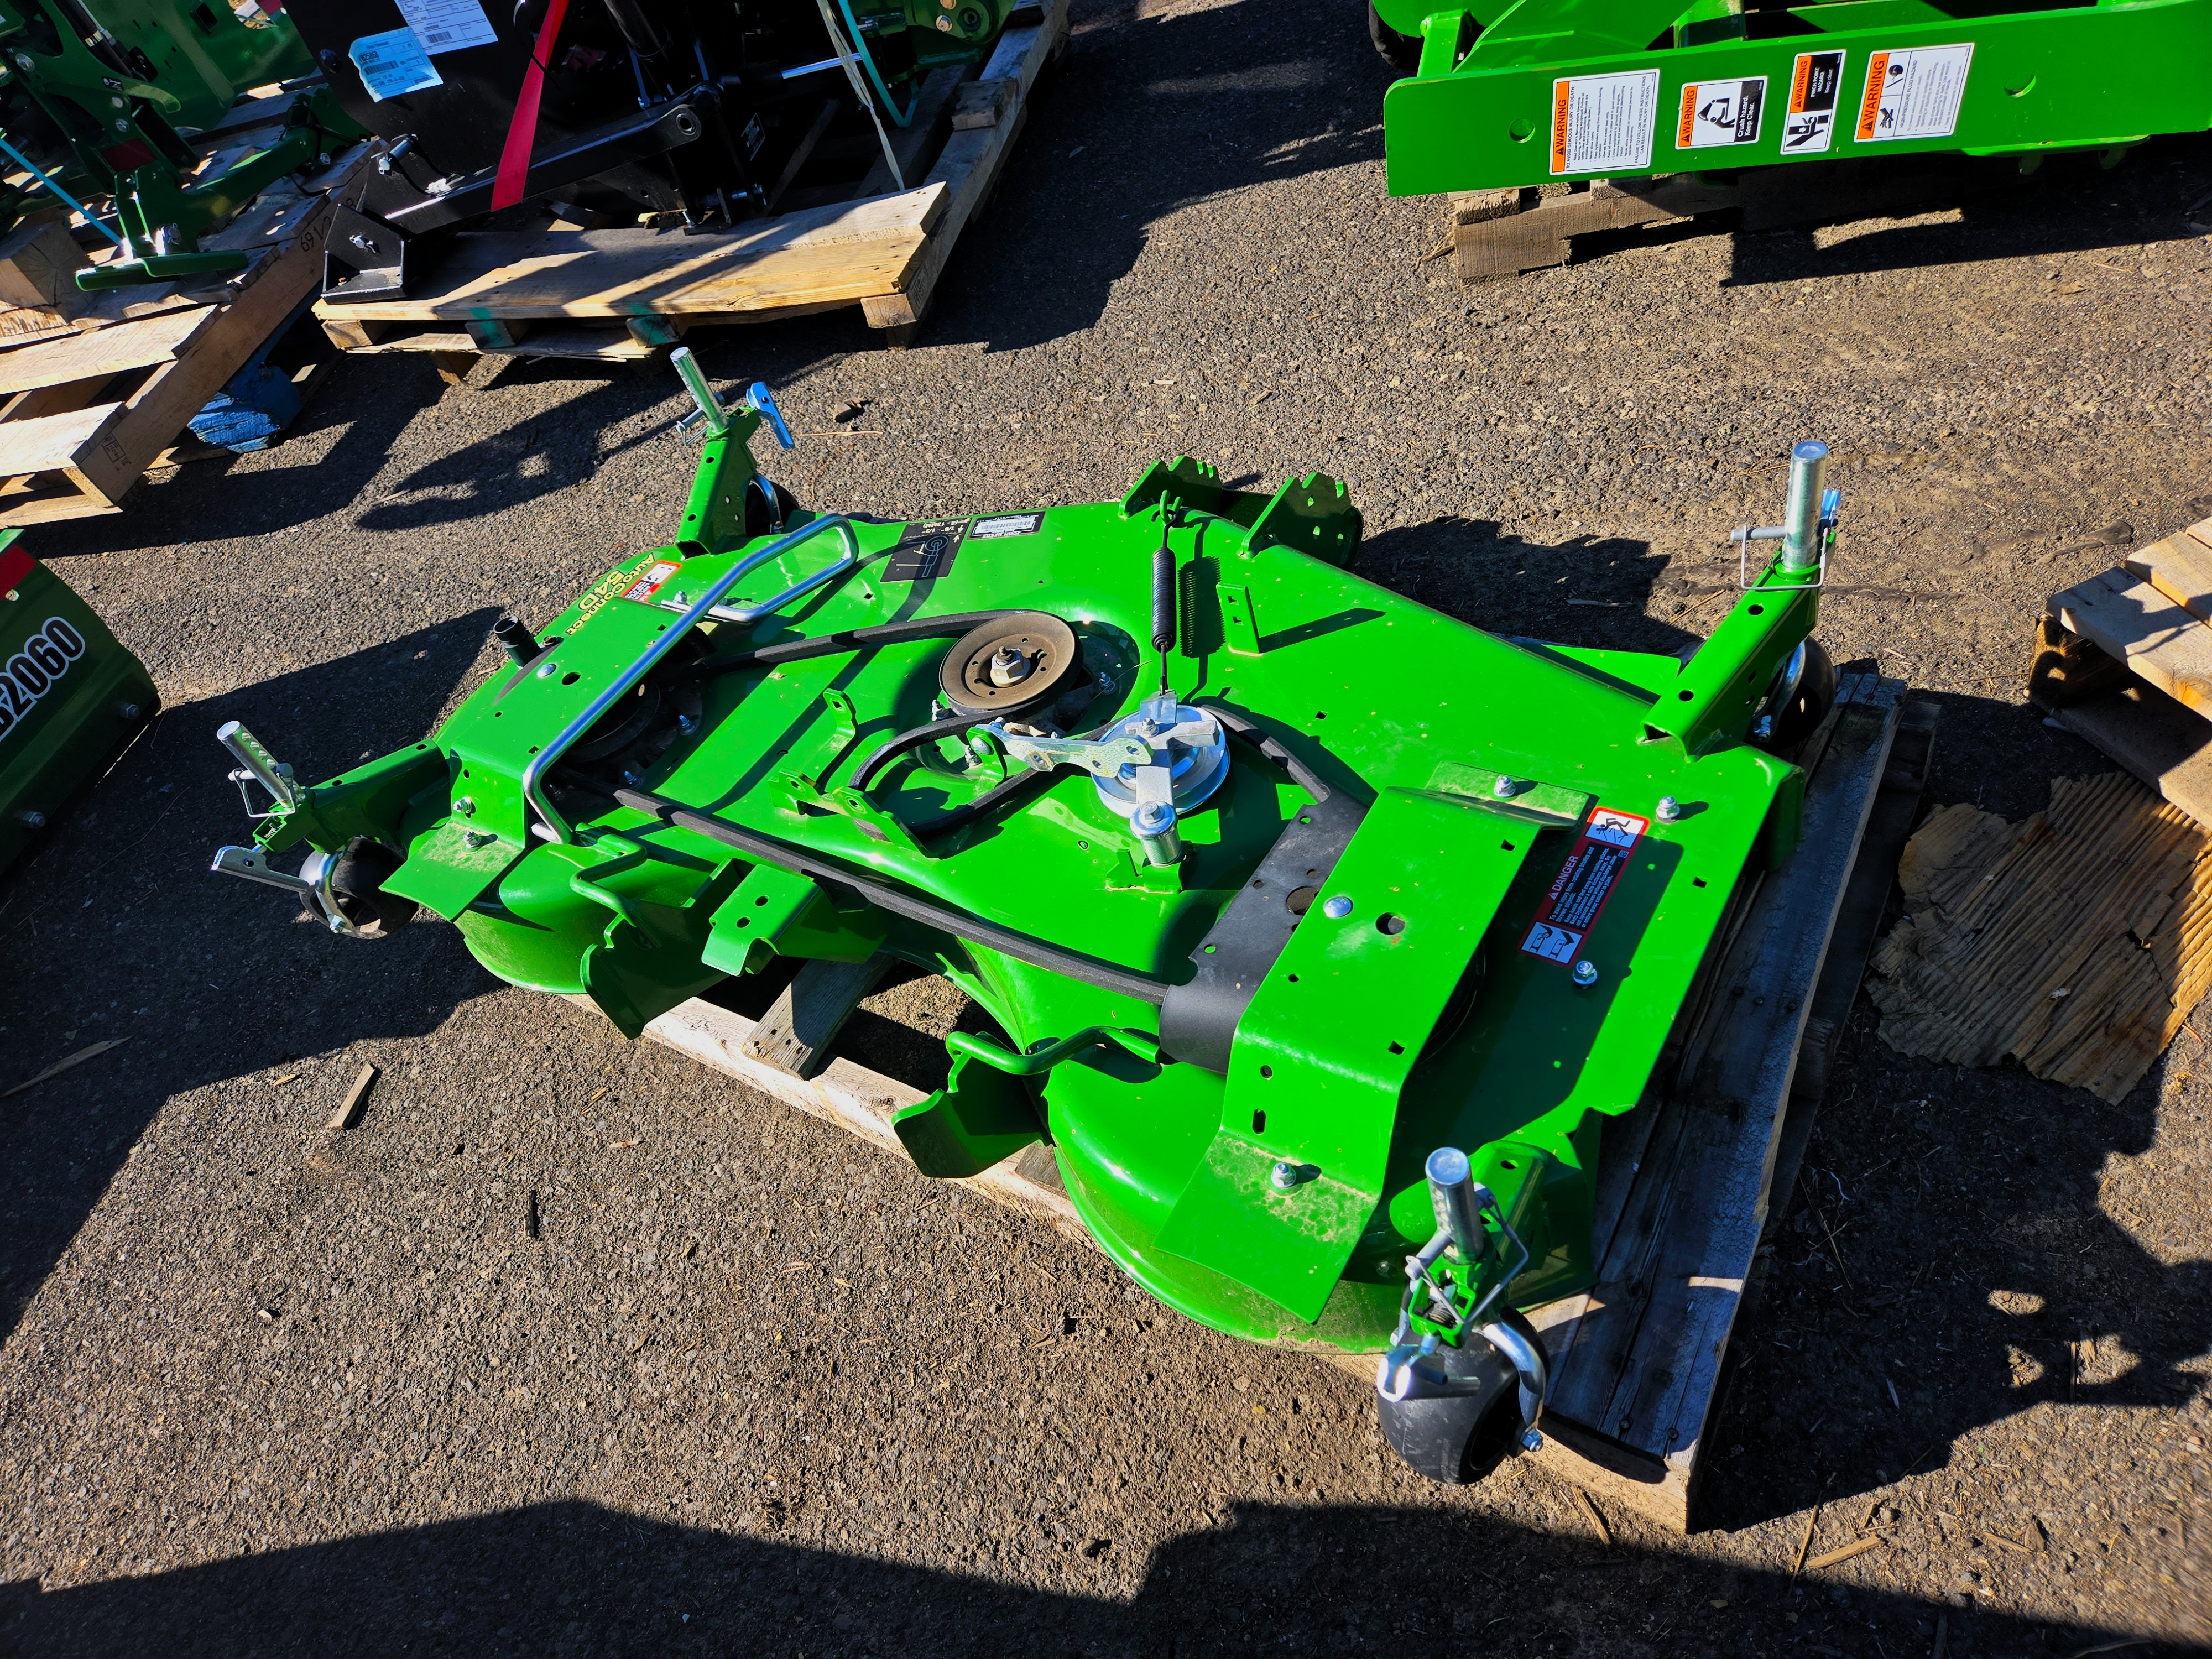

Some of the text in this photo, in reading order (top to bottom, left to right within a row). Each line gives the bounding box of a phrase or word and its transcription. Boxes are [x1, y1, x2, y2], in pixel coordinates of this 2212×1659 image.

[1794, 61, 1808, 100] WARNING
[1863, 60, 1885, 121] WARNING
[1556, 99, 1566, 147] WARNING
[1682, 90, 1694, 134] WARNING
[1736, 95, 1748, 137] Crush hazard.
[1744, 102, 1755, 136] Keep Clear.
[1899, 93, 1910, 127] HIGH-PRESSURE
[300, 232, 314, 252] 69
[565, 552, 655, 635] AutoConnect
[579, 570, 625, 610] 54D
[1552, 855, 1579, 891] DANGER
[1553, 903, 1563, 914] avoid
[1559, 891, 1570, 903] injury
[1566, 882, 1574, 891] from
[1571, 867, 1584, 883] rotating
[1579, 854, 1590, 867] blades
[1564, 913, 1573, 922] Keep
[1569, 902, 1579, 914] hands
[1584, 880, 1593, 890] away
[1593, 859, 1604, 873] rotating
[1580, 906, 1590, 920] operate
[1588, 894, 1596, 906] mower
[1593, 881, 1603, 894] without
[1600, 865, 1613, 881] discharge
[1556, 907, 1567, 922] thrown
[1570, 915, 1579, 924] Keep
[1575, 895, 1589, 915] bystanders
[1592, 871, 1602, 885] distance
[1584, 912, 1592, 923] entire
[1590, 902, 1598, 912] grass
[1595, 889, 1605, 902] catcher
